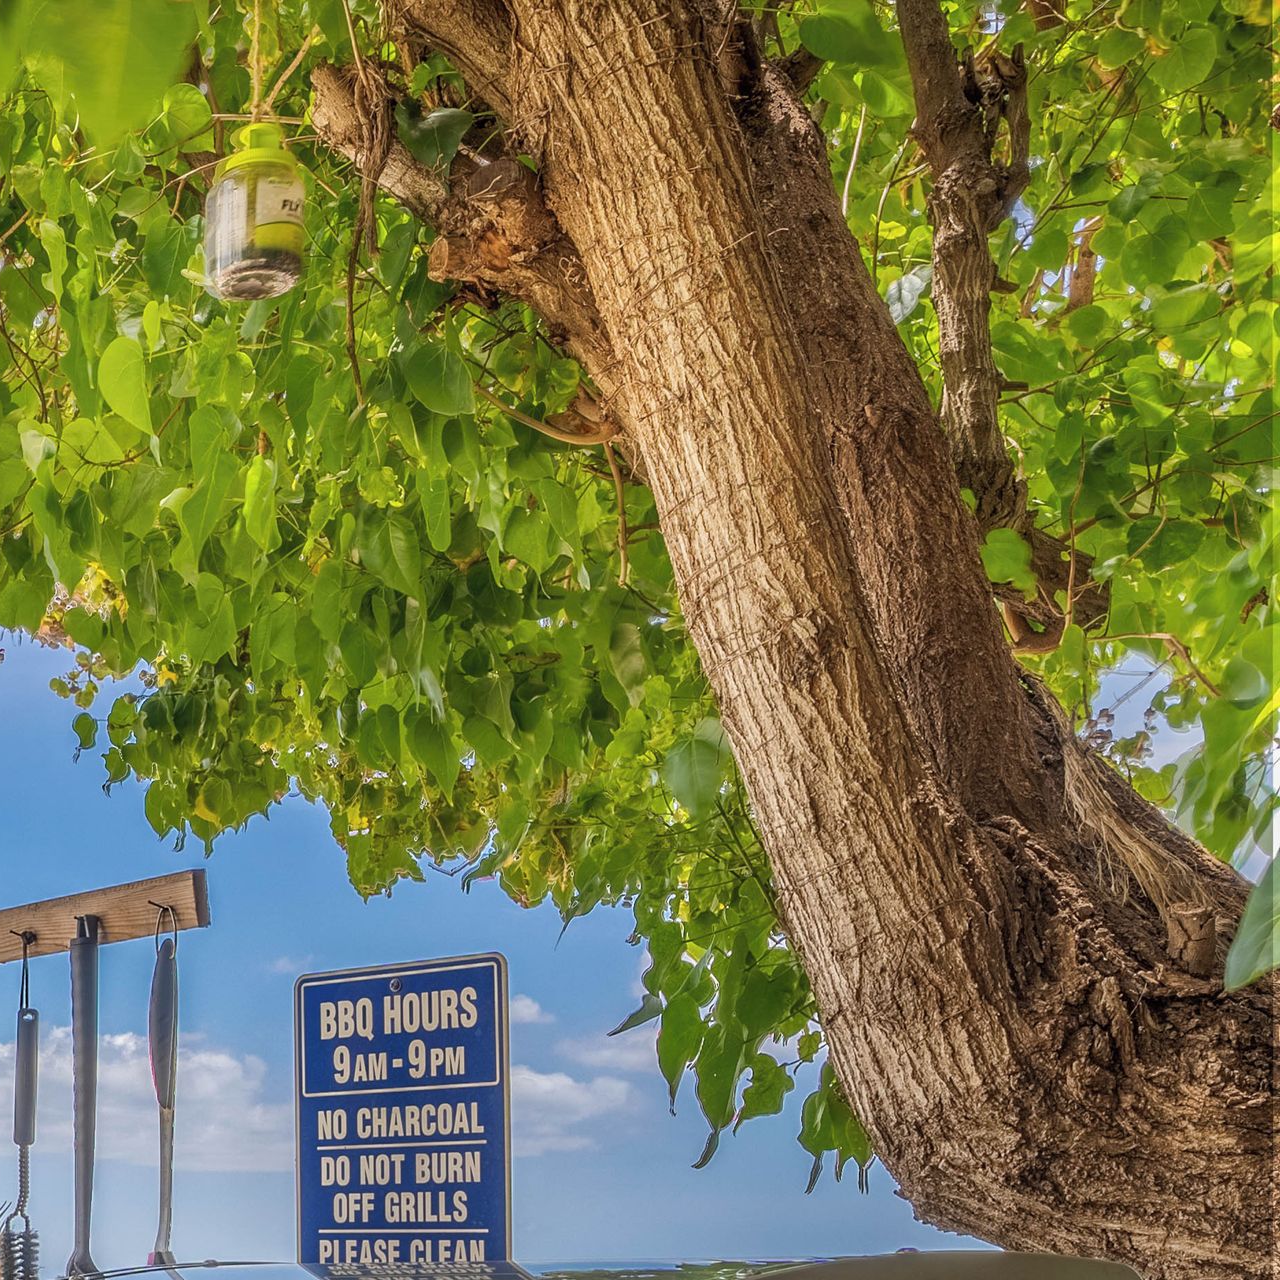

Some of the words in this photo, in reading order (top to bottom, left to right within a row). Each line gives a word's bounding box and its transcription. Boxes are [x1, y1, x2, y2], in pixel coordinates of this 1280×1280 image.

[320, 997, 374, 1040] BBQ
[383, 986, 478, 1035] HOURS
[317, 1109, 347, 1141] NO
[356, 1102, 485, 1138] CHARCOAL
[320, 1155, 351, 1187] DO
[359, 1154, 405, 1185] NOT
[415, 1151, 481, 1184] BURN
[333, 1193, 375, 1224] OFF
[384, 1190, 468, 1223] GRILLS
[319, 1239, 400, 1265] PLEASE
[410, 1239, 485, 1264] CLEAN
